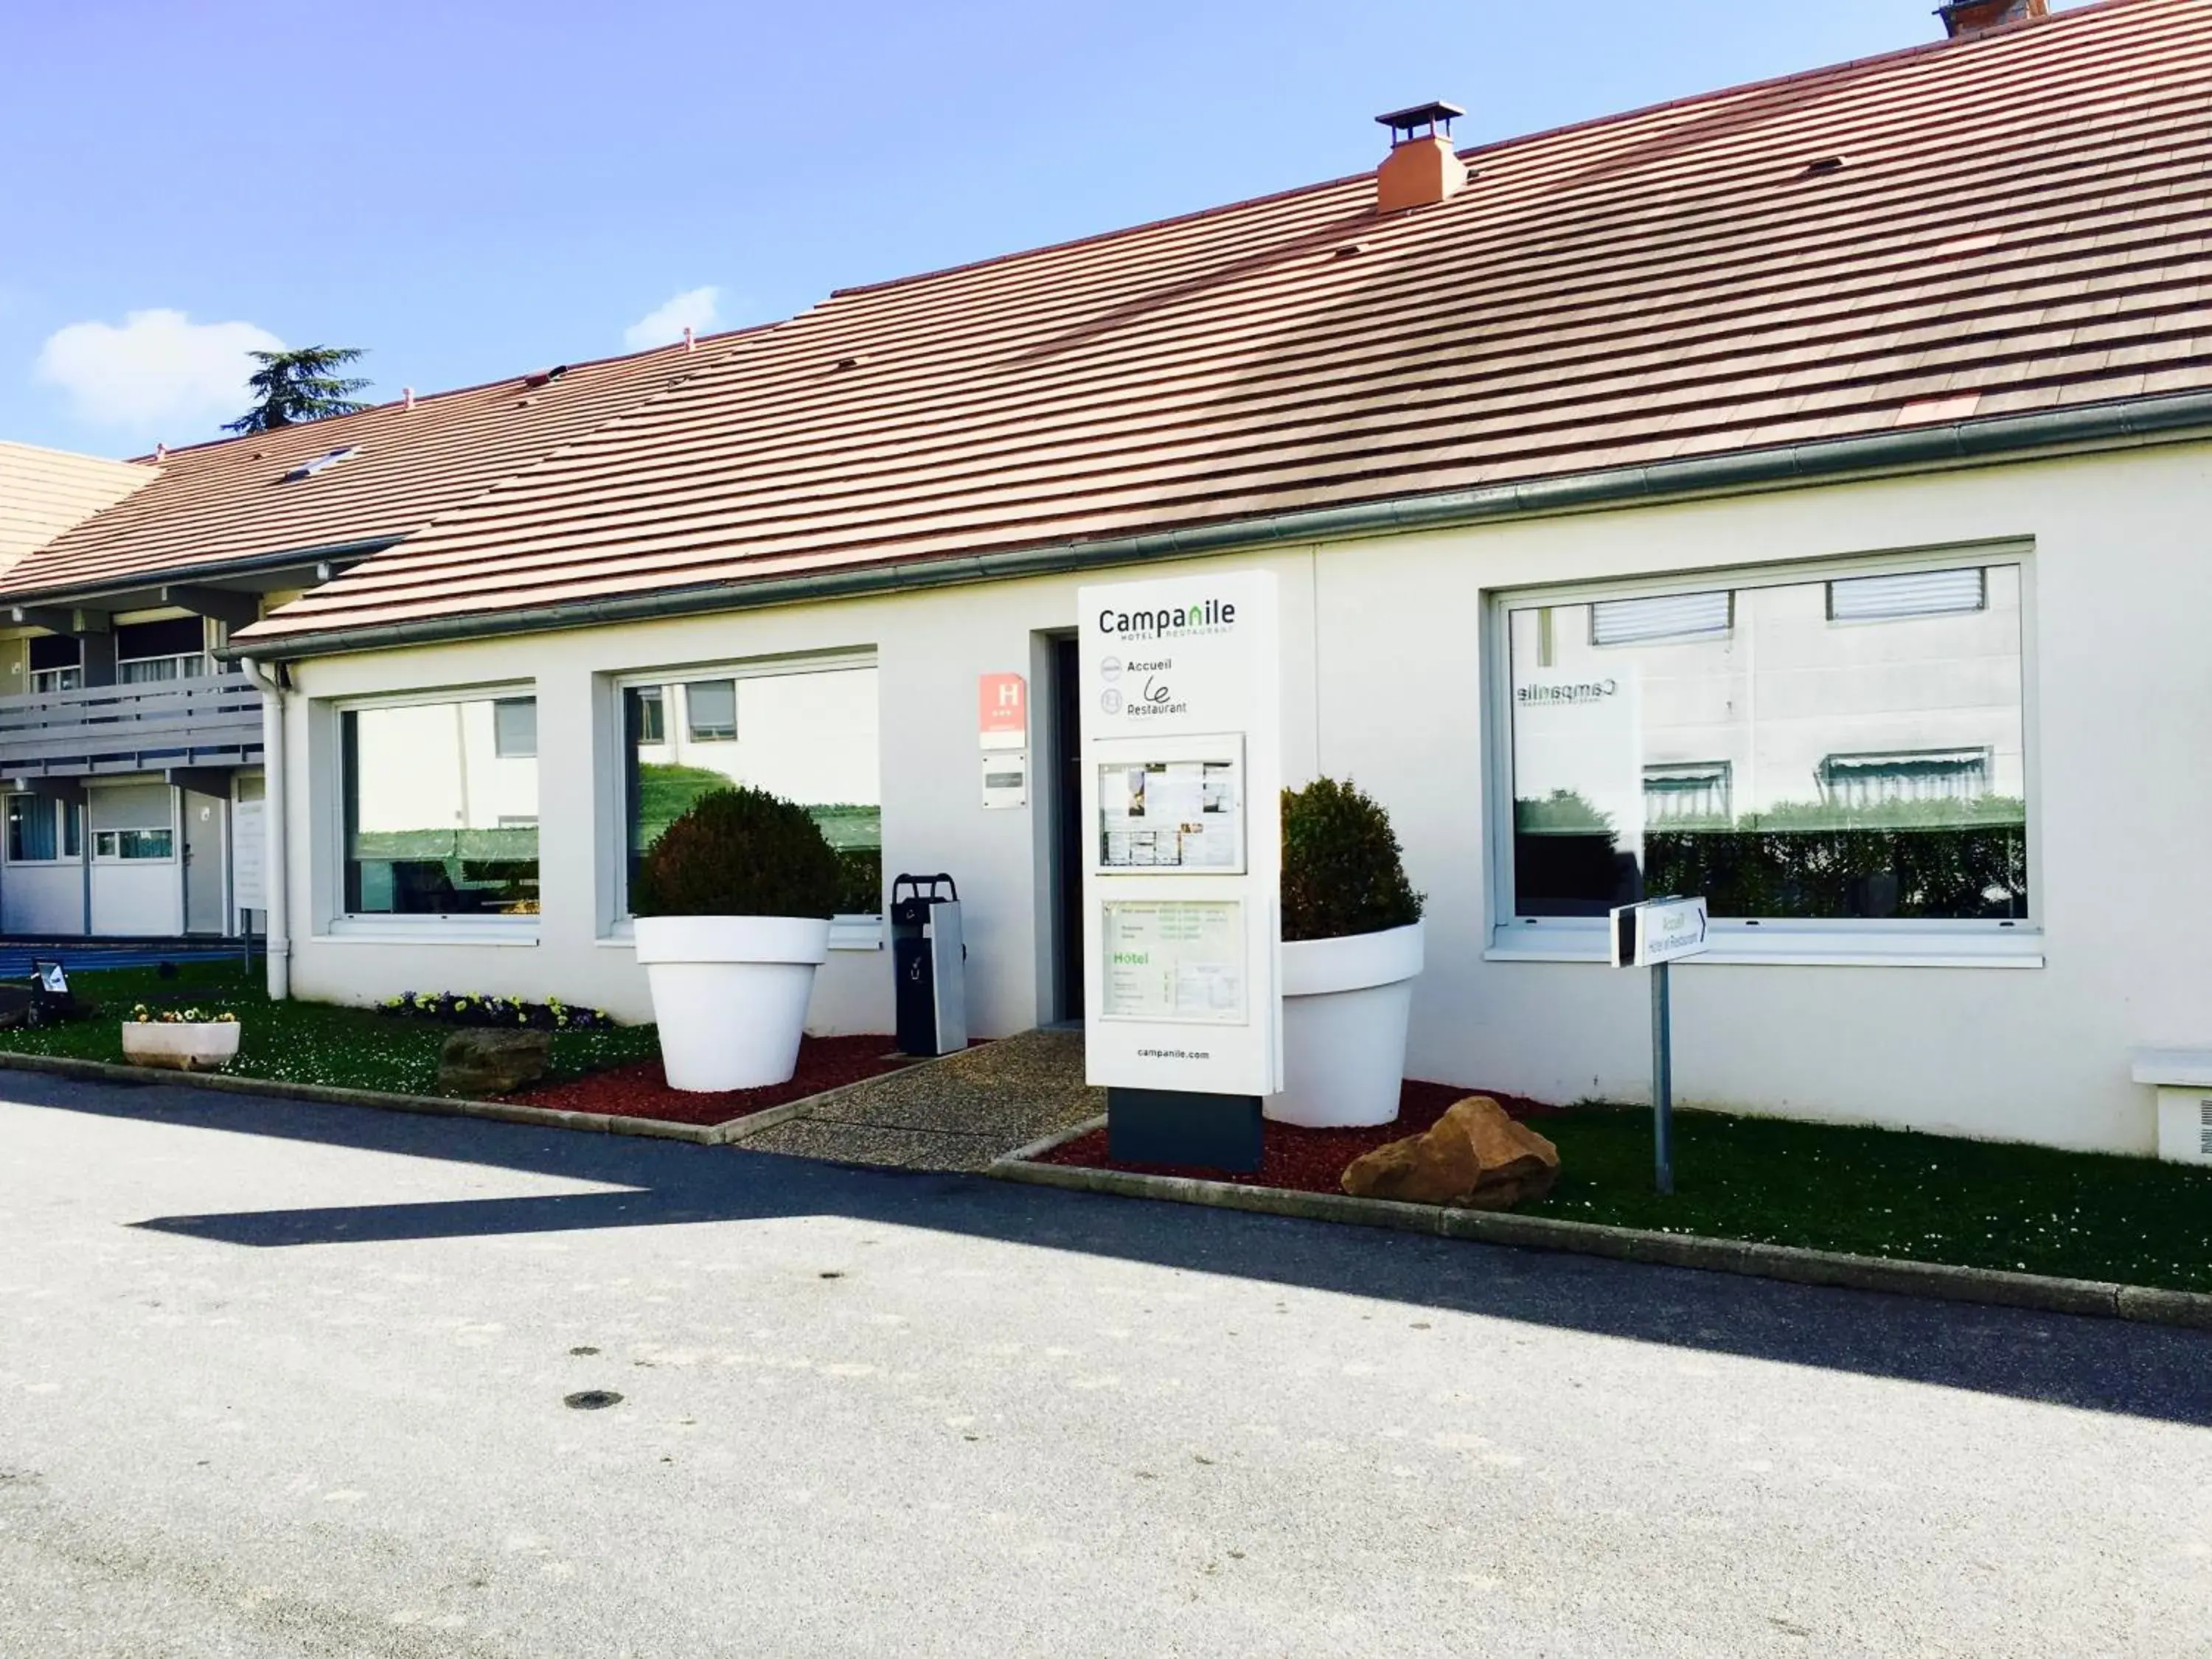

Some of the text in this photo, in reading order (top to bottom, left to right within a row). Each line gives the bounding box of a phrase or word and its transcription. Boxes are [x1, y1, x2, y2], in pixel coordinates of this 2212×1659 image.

[1099, 599, 1235, 638] Campanile
[1127, 658, 1172, 672] Accueil
[999, 684, 1018, 706] H
[1127, 703, 1187, 715] Restaurant
[1138, 1048, 1210, 1060] campanile.com
